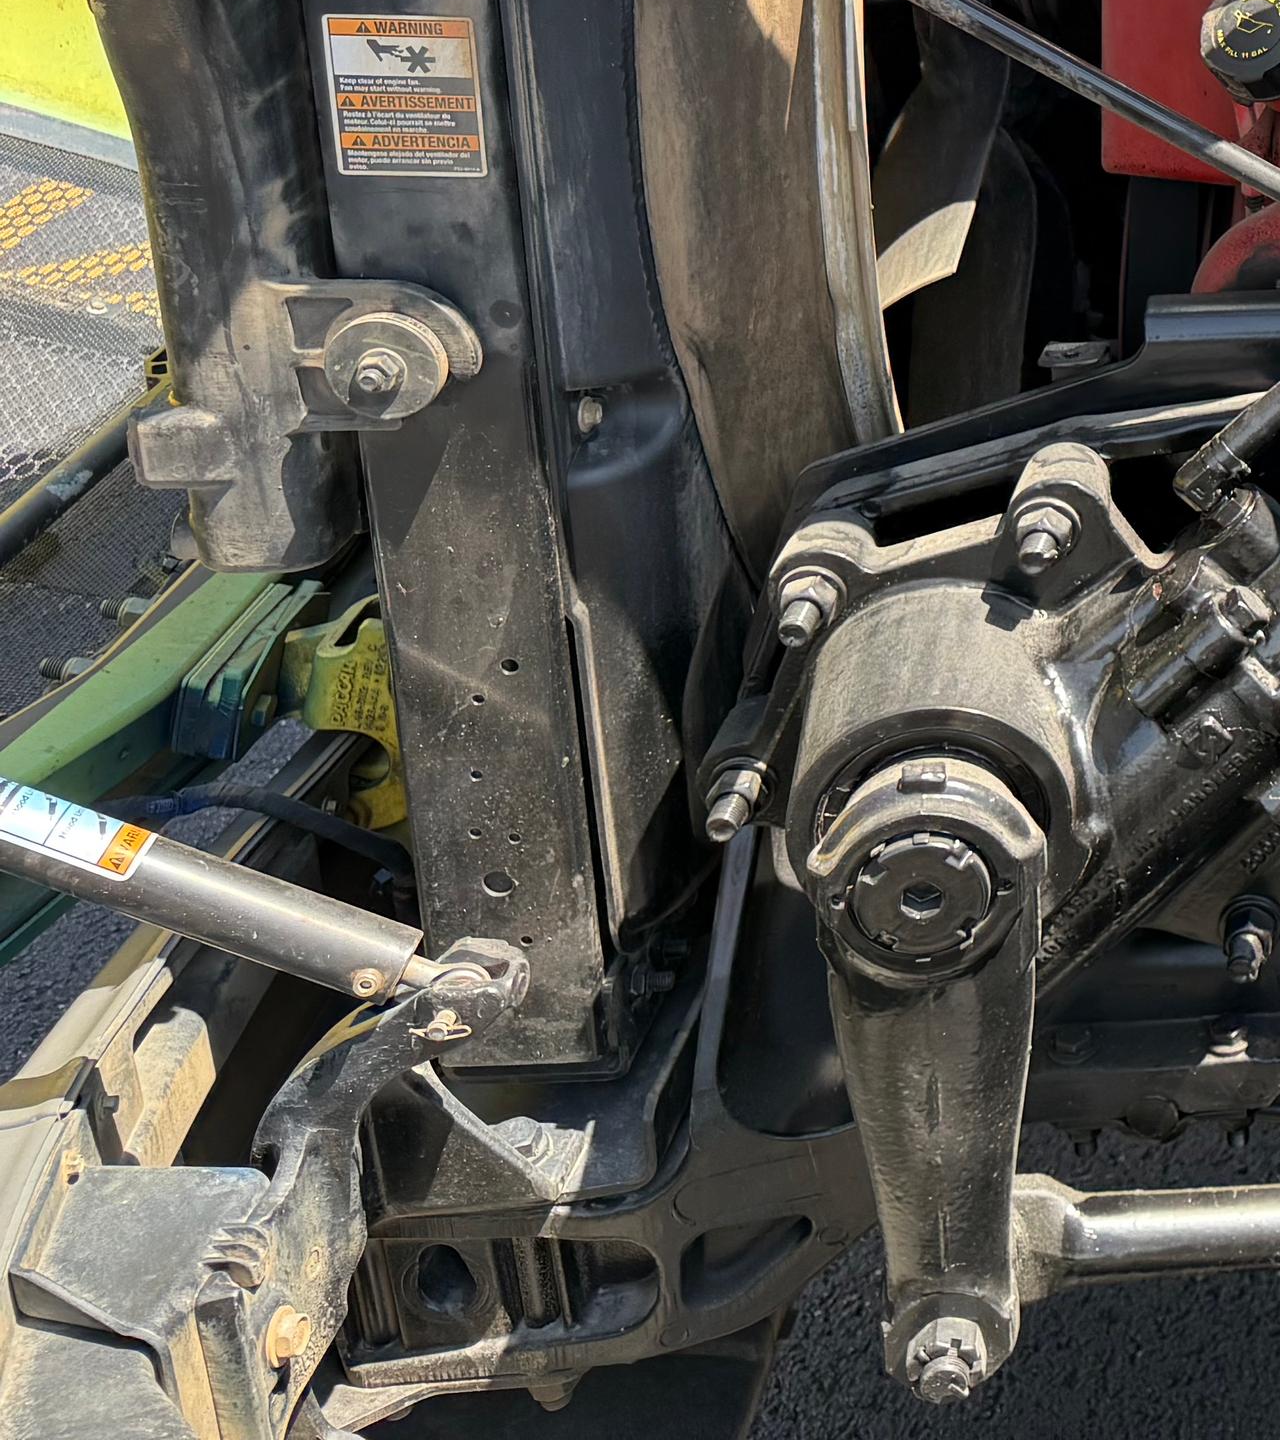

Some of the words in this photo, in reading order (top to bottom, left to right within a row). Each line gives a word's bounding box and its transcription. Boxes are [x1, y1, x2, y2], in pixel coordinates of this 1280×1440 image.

[374, 21, 443, 35] WARNING
[339, 77, 356, 85] Keep
[361, 96, 473, 109] AVERTISSEMENT
[372, 136, 471, 148] ADVERTENCIA
